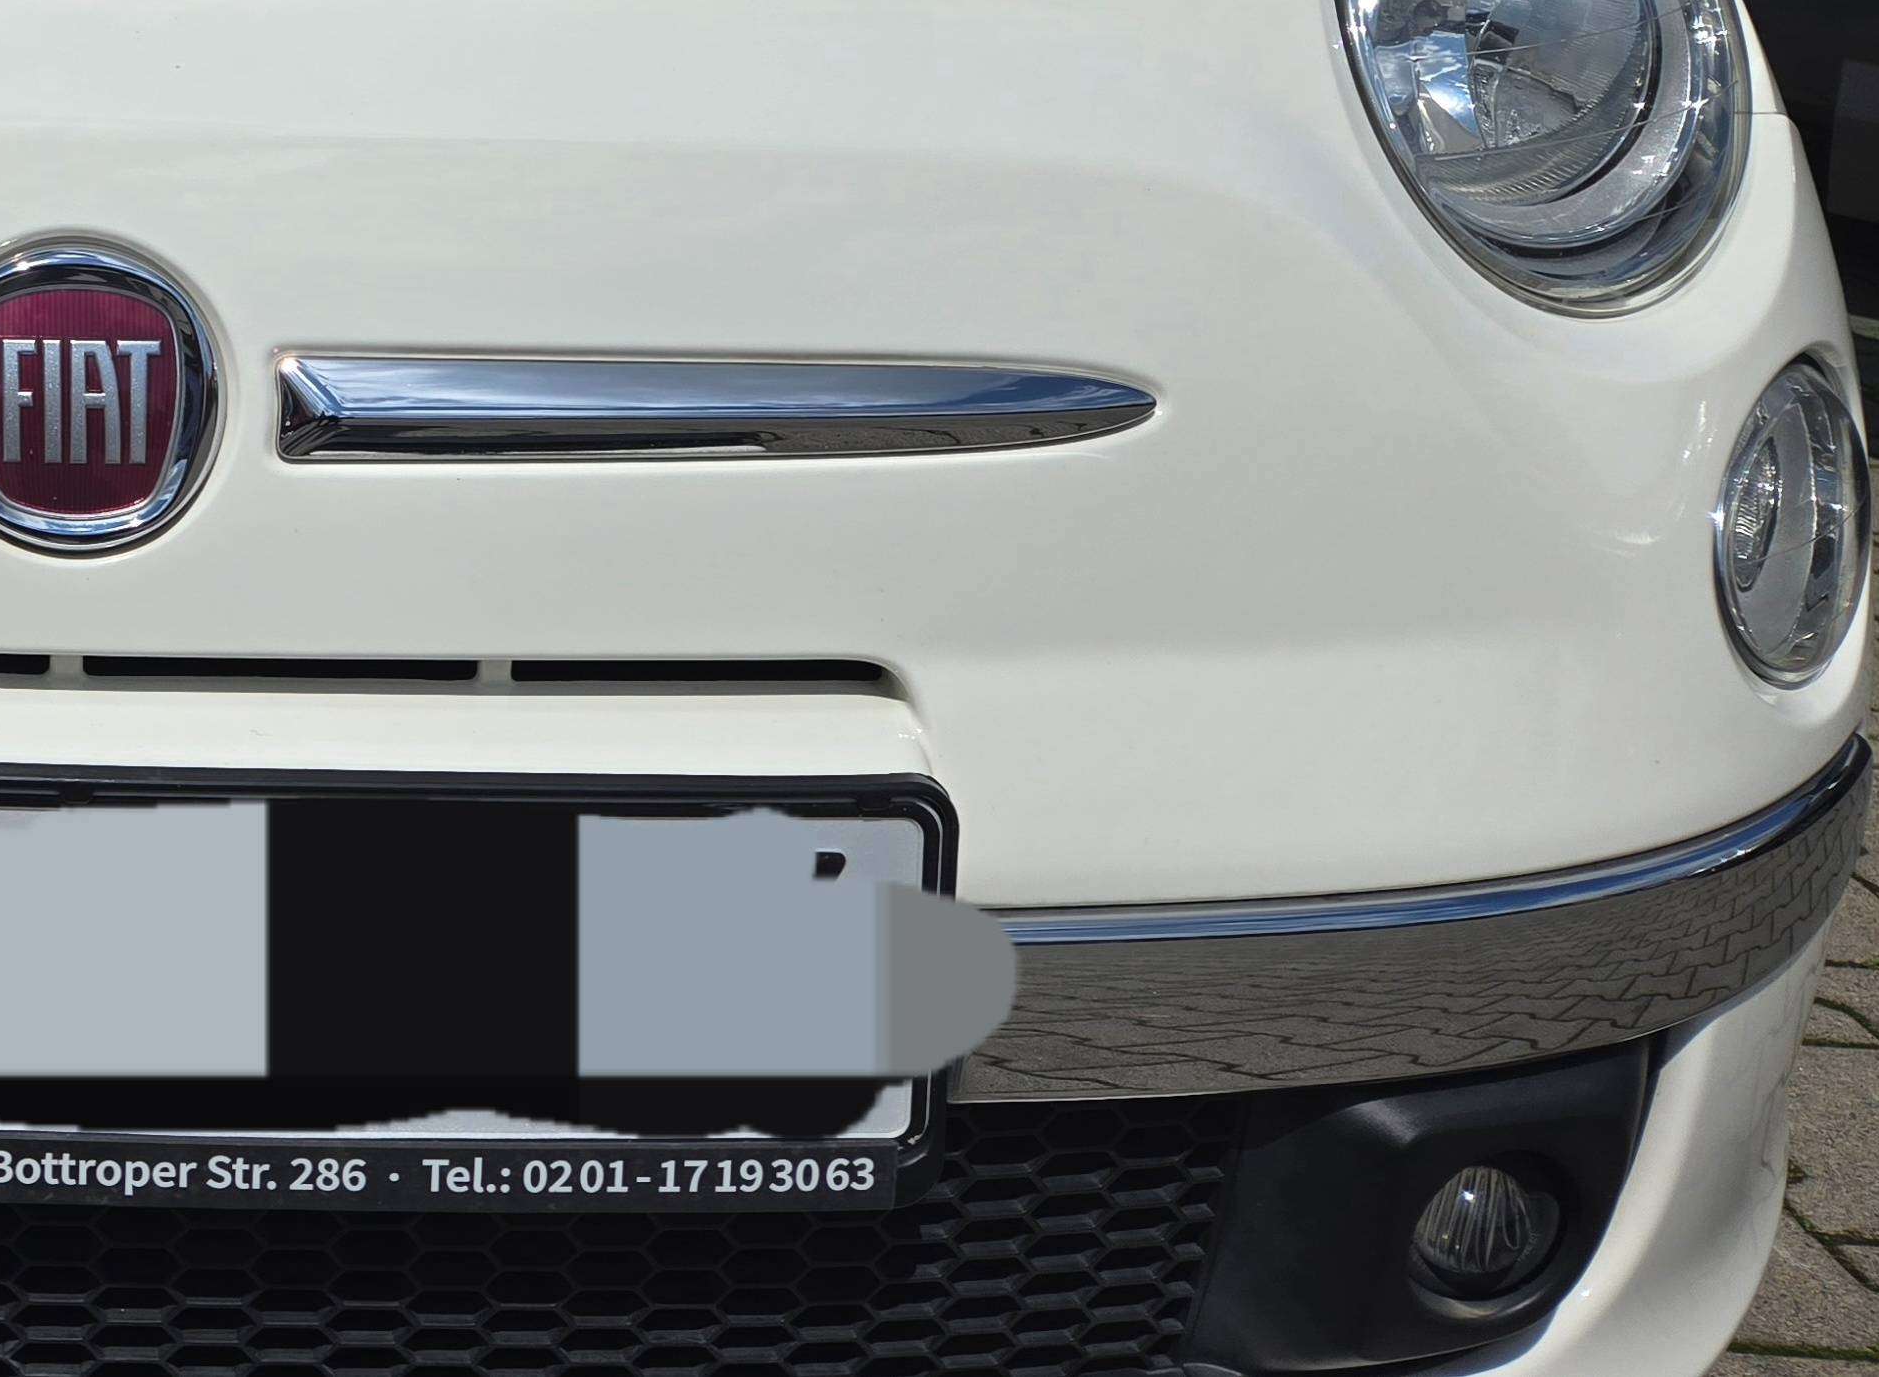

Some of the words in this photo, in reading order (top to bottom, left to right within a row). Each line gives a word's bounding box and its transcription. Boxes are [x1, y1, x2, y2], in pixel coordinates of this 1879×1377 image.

[1, 338, 163, 465] FIAT
[206, 1155, 277, 1191] Str.
[289, 1157, 367, 1192] 286
[422, 1157, 511, 1194] Tel.:
